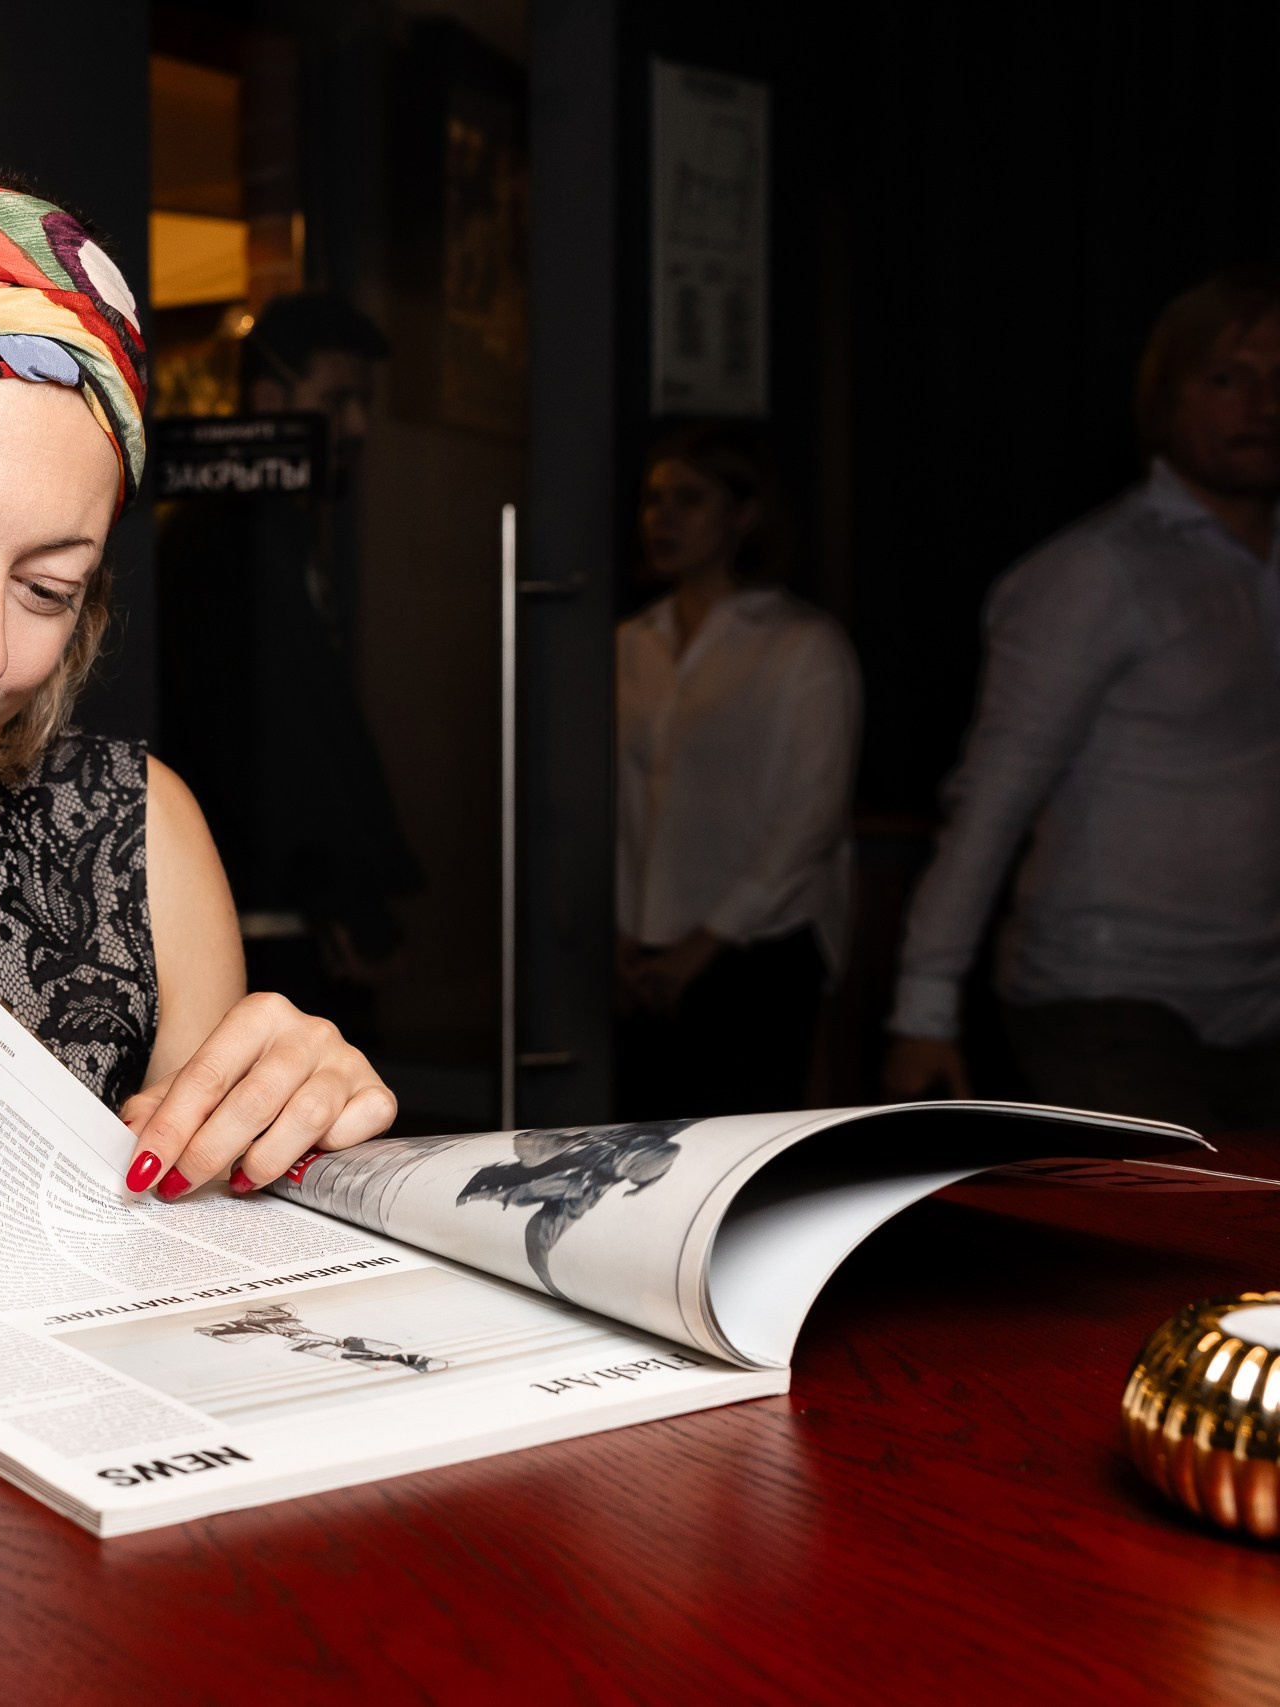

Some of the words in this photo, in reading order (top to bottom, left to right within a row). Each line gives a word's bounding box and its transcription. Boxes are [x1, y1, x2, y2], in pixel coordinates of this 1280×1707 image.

[4, 1104, 32, 1132] comunicazione,
[2, 1131, 10, 1140] qui
[17, 1130, 30, 1143] punto
[32, 1128, 40, 1138] una
[10, 1137, 18, 1146] ma
[28, 1140, 35, 1148] un
[38, 1136, 54, 1151] creando
[4, 1145, 13, 1156] cosa
[18, 1142, 40, 1164] occidentale,
[56, 1151, 62, 1159] di
[12, 1152, 20, 1162] una
[40, 1162, 45, 1170] un
[61, 1154, 80, 1174] importanti
[2, 1168, 10, 1179] una
[18, 1168, 30, 1181] mura
[49, 1170, 54, 1178] di
[52, 1161, 76, 1182] sicuramente
[80, 1170, 88, 1180] più
[10, 1176, 26, 1190] quindi
[29, 1177, 40, 1190] dalle
[54, 1174, 74, 1194] Biennale
[86, 1176, 100, 1188] eventi
[26, 1186, 40, 1200] tratta
[46, 1190, 52, 1199] 31
[74, 1188, 80, 1198] La
[99, 1184, 111, 1196] degli
[16, 1200, 28, 1213] Mall
[54, 1204, 62, 1212] un
[58, 1197, 73, 1208] entro
[5, 1204, 35, 1222] particolare
[30, 1208, 40, 1218] tral
[108, 1205, 130, 1214] Davide
[0, 1211, 24, 1226] occupato
[4, 1222, 14, 1231] dei
[14, 1226, 42, 1239] progetto
[348, 1256, 400, 1269] UNA
[243, 1265, 350, 1291] BIENNALE
[192, 1284, 240, 1298] PER
[97, 1445, 251, 1486] NEWS
